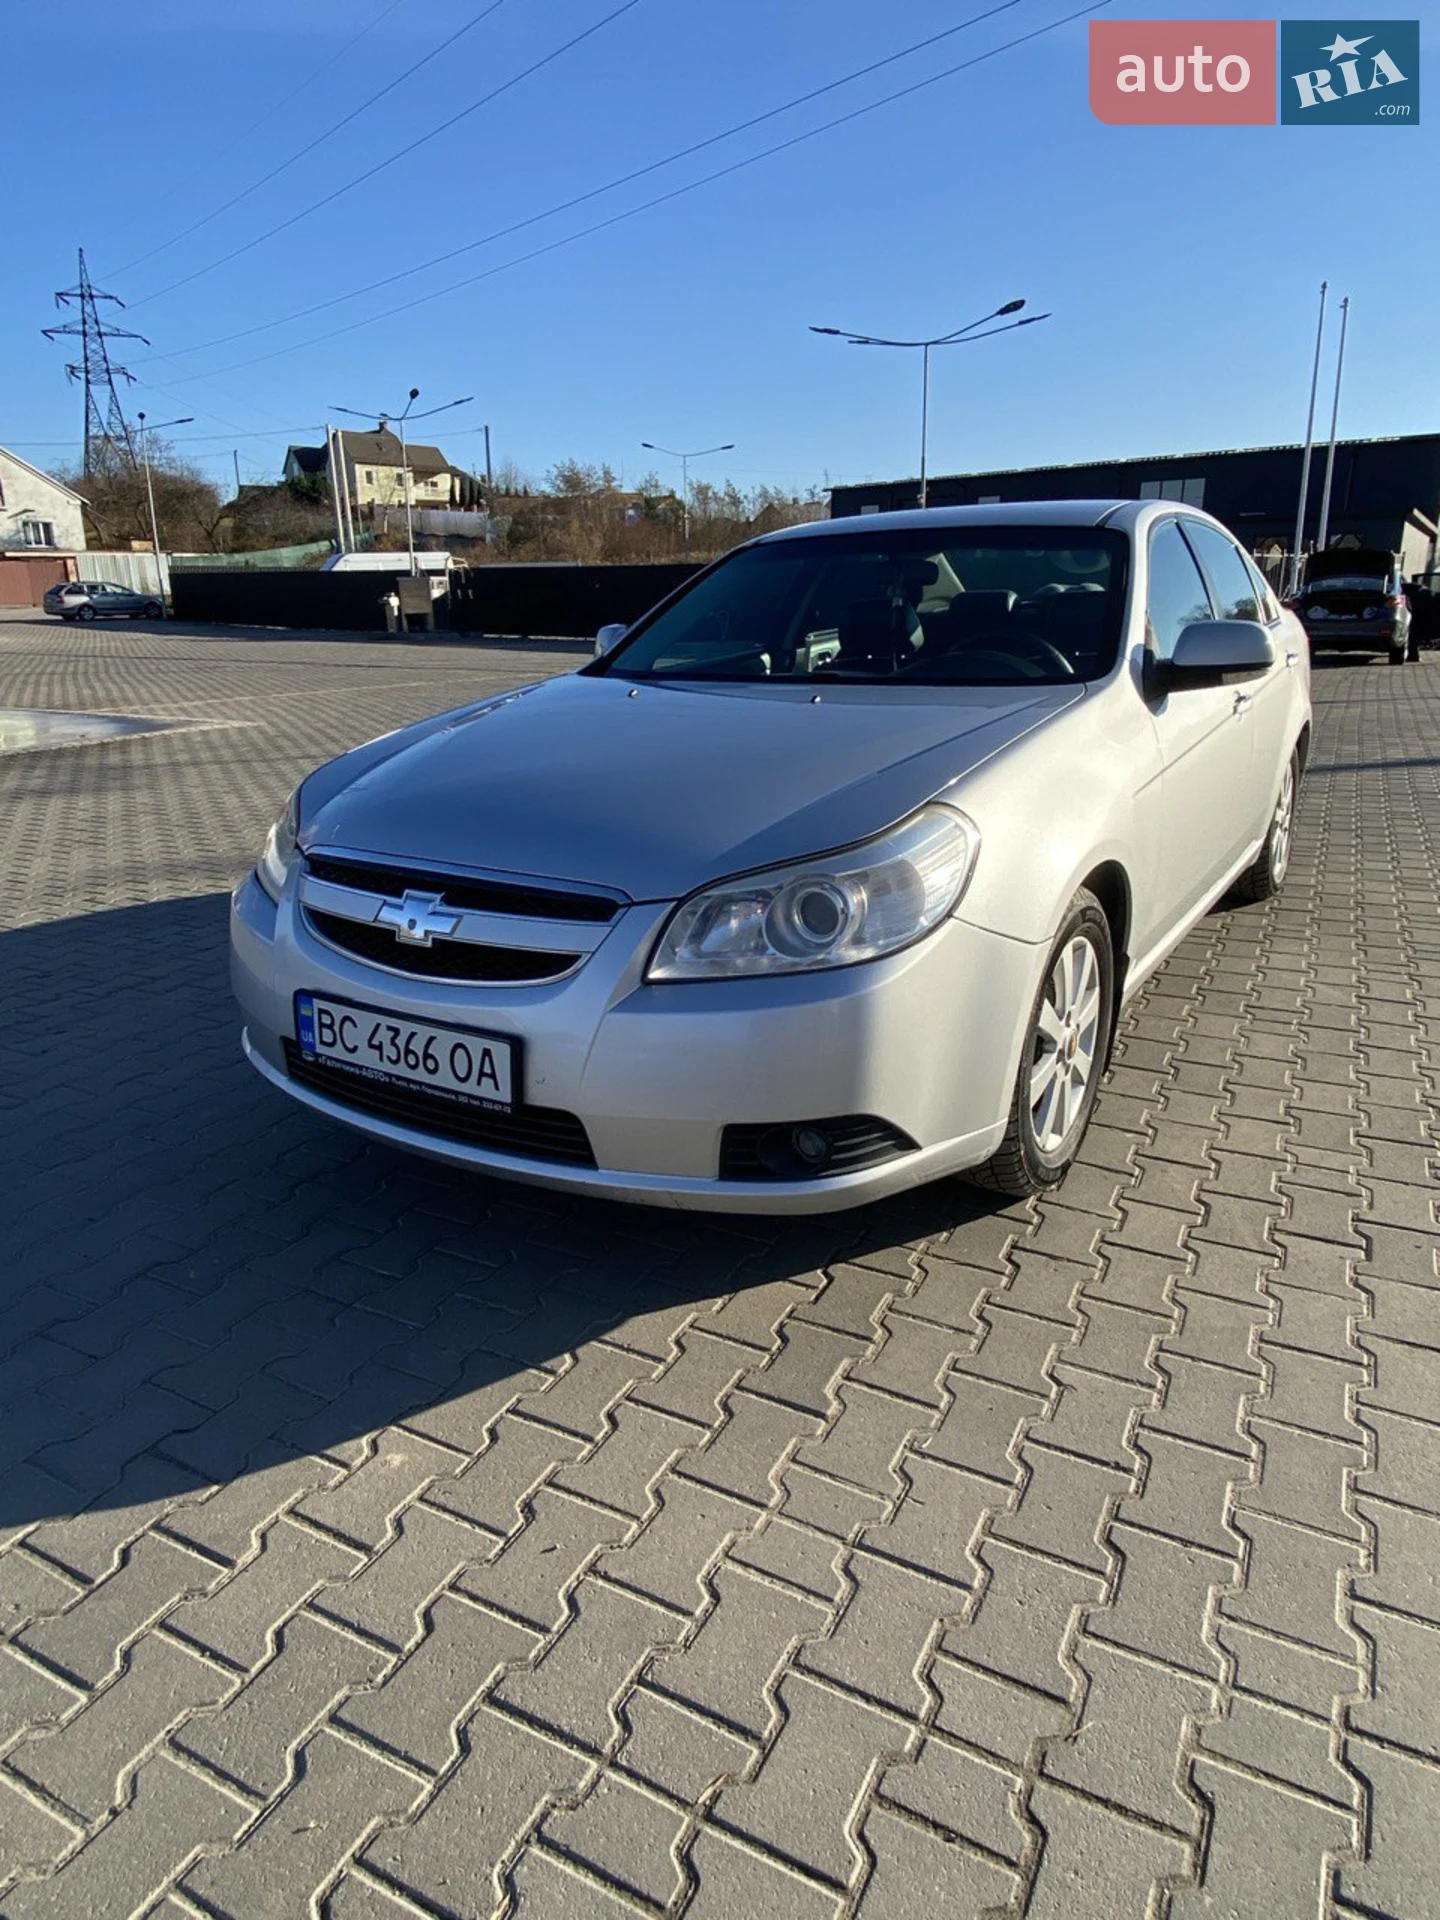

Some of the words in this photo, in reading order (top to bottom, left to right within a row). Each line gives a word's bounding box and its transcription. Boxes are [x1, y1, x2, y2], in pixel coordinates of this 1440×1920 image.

[301, 1030, 314, 1043] UA
[317, 1007, 359, 1054] BC
[367, 1022, 440, 1076] 4366
[450, 1042, 500, 1092] OA
